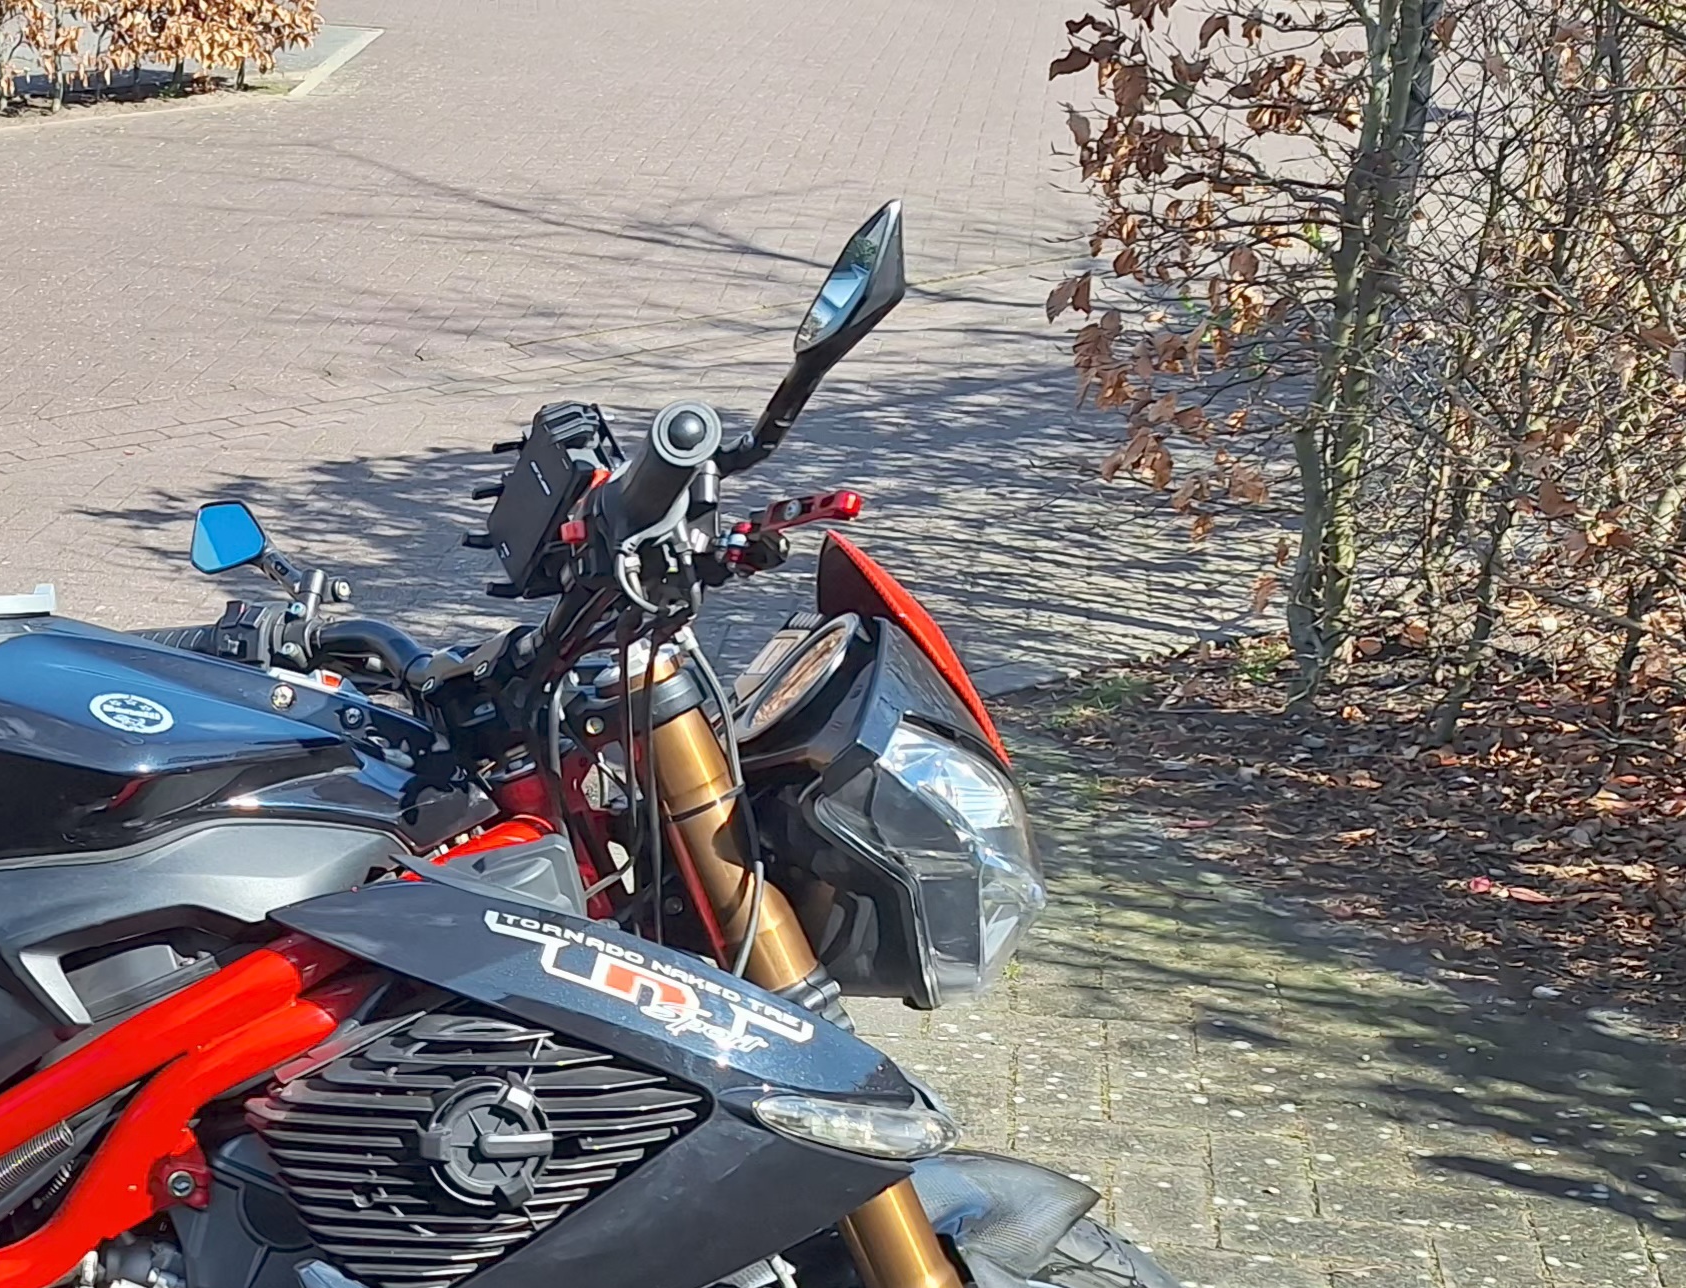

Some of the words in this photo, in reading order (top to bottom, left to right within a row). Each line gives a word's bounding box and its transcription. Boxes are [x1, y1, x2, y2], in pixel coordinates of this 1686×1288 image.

[502, 913, 645, 966] TORNADO
[650, 958, 742, 1004] NAKED
[747, 998, 805, 1026] TRE
